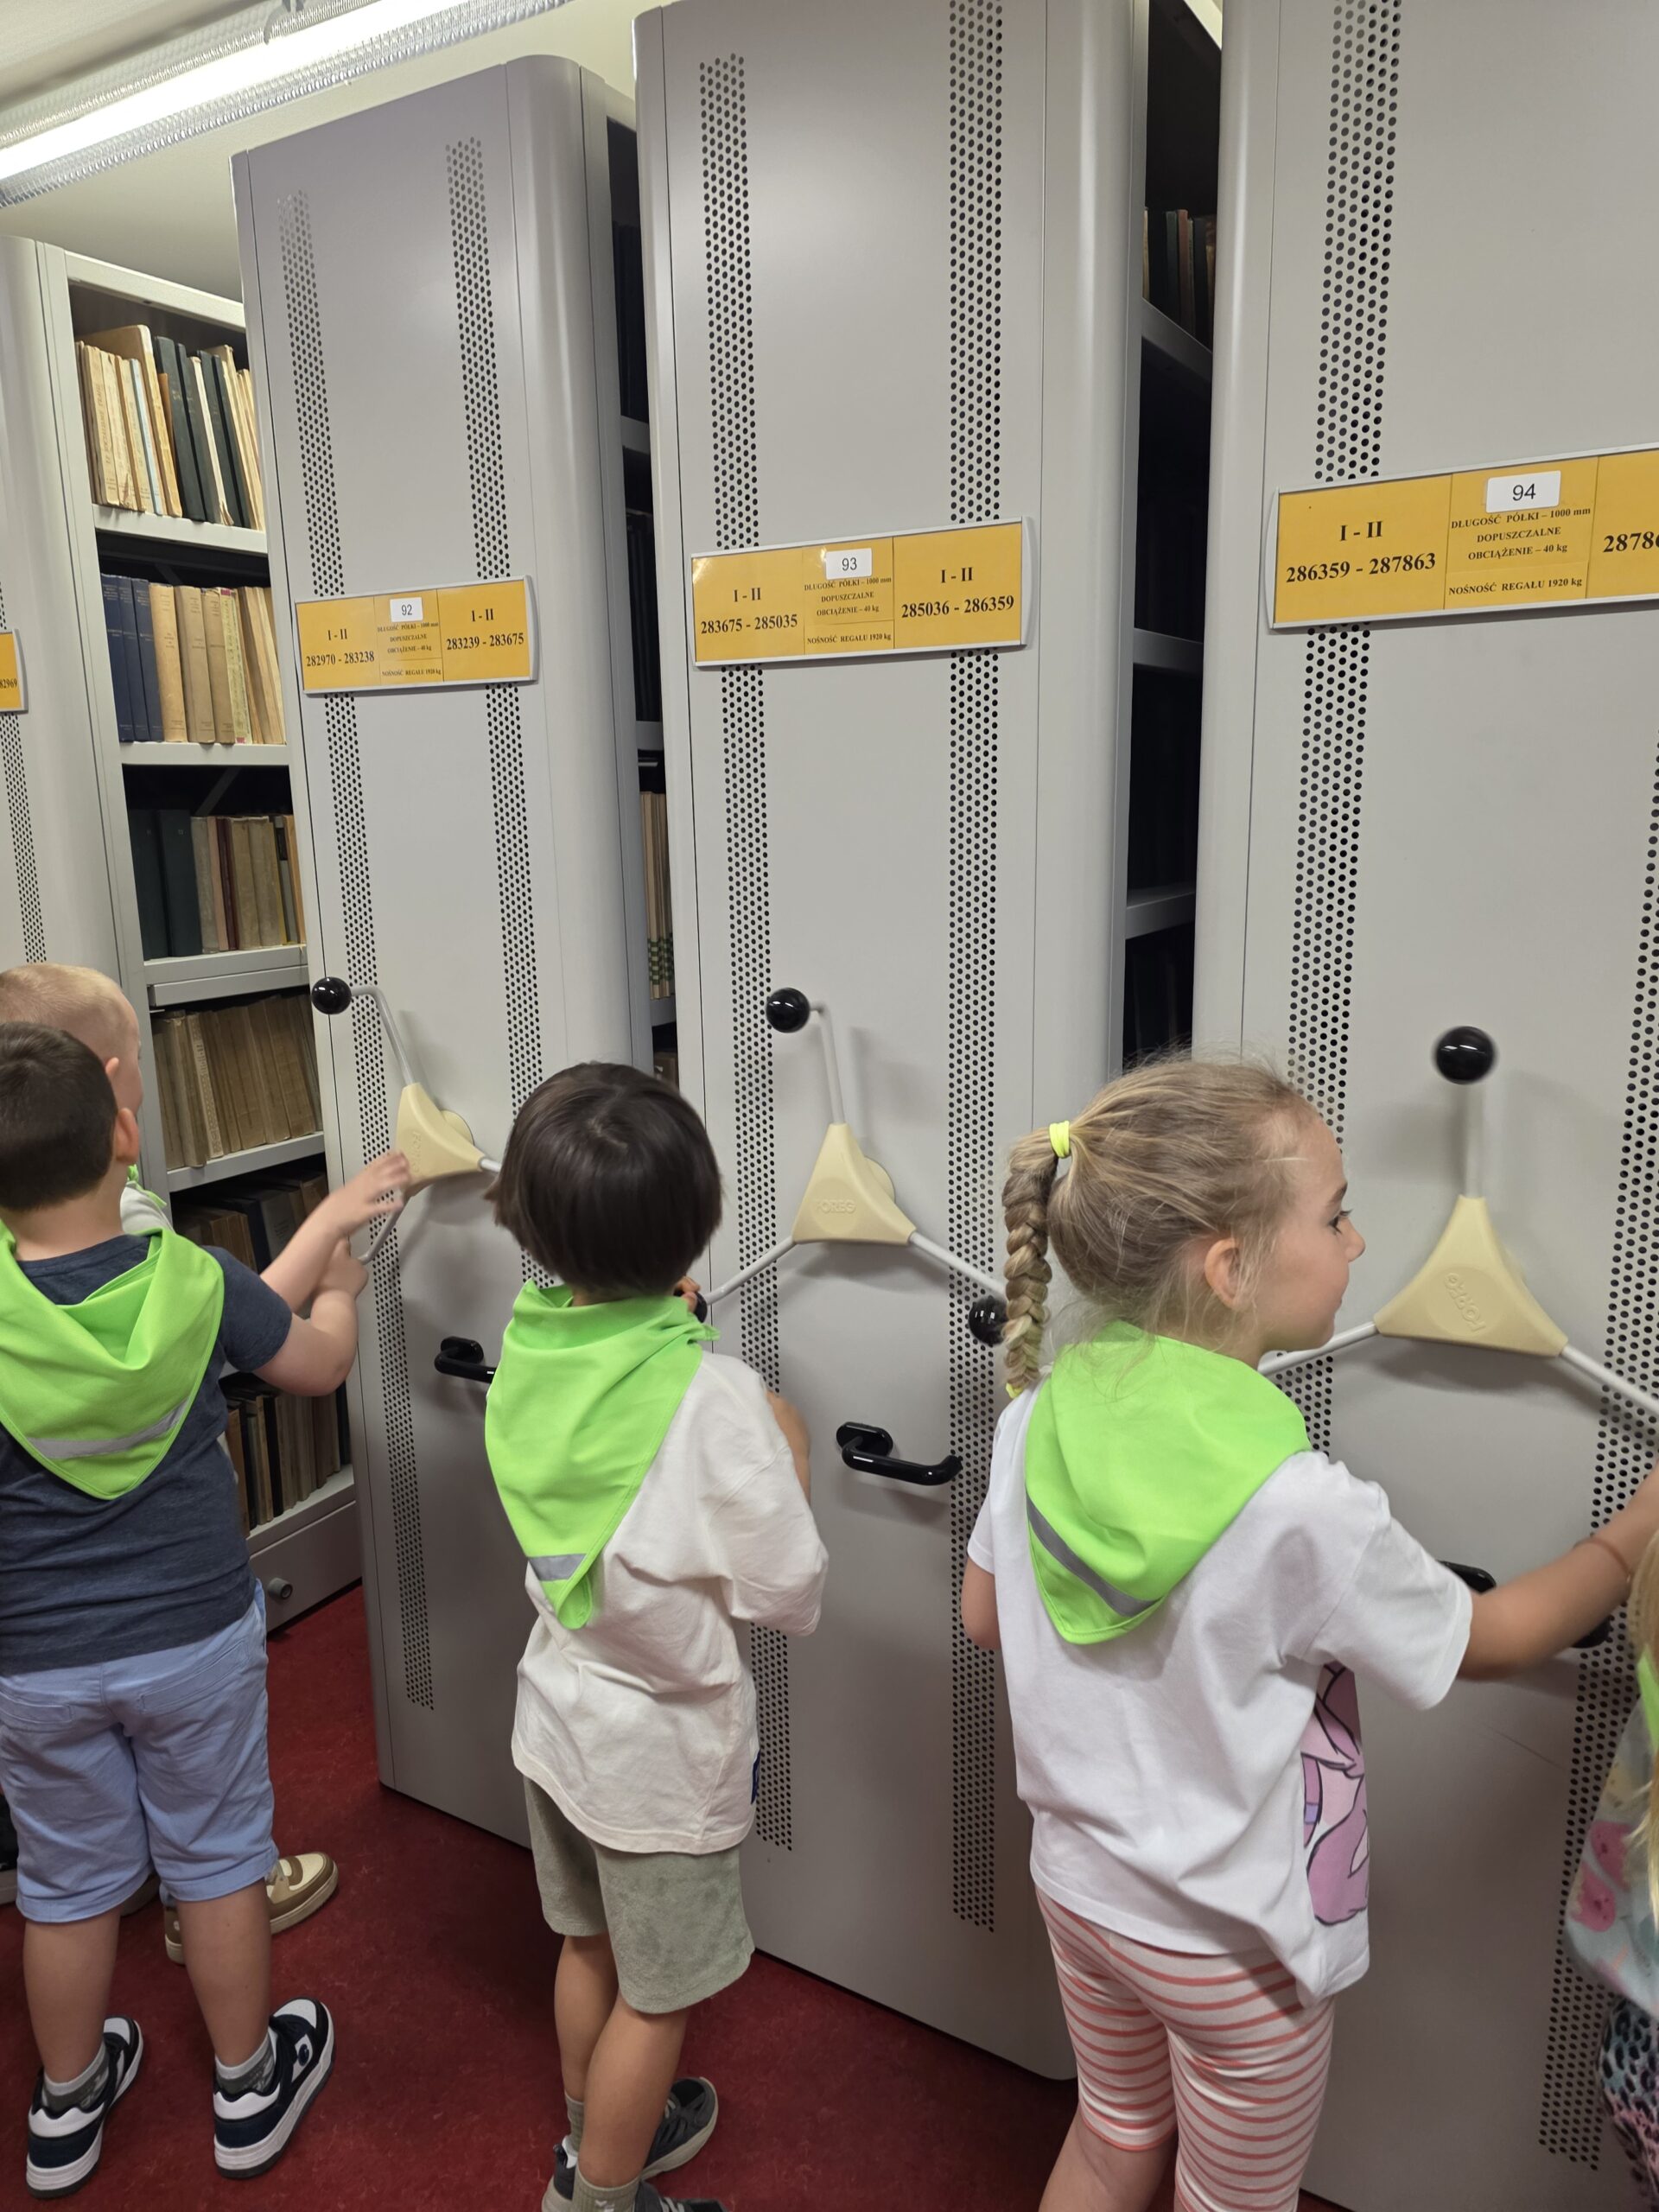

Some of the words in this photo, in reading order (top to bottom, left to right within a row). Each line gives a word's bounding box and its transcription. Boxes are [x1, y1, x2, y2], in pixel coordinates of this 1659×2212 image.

[1512, 483, 1536, 501] 94
[1451, 513, 1502, 529] DŁUGOŚĆ
[1506, 511, 1539, 523] PÓŁKI
[1550, 508, 1571, 518] 1000
[1573, 507, 1591, 516] mm
[1366, 520, 1382, 538] II
[1477, 526, 1561, 543] DOPUSZCZALNE
[1603, 531, 1659, 553] 2878
[1468, 544, 1533, 561] OBCIĄŻENIE
[1543, 544, 1554, 553] 40
[1556, 543, 1567, 553] kg
[842, 557, 857, 571] 93
[1286, 561, 1351, 583] 286359
[1369, 552, 1436, 575] 287863
[961, 567, 974, 582] II
[804, 581, 836, 591] DŁUGOŚĆ
[838, 578, 860, 588] PÓŁKI
[1448, 582, 1497, 596] NOŚNOŚĆ
[1502, 579, 1545, 592] REGAŁU
[1548, 578, 1568, 588] 1920
[1571, 577, 1582, 588] kg
[751, 588, 761, 601] II
[821, 591, 874, 602] DOPUSZCZALNE
[401, 604, 412, 616] 92
[817, 606, 858, 617] OBCIĄŻENIE
[901, 601, 950, 618] 285036
[964, 594, 1014, 614] 286359
[701, 618, 742, 634] 283675
[754, 613, 798, 630] 285035
[446, 636, 480, 651] 283239
[489, 632, 524, 647] 283675
[807, 634, 837, 645] NOŚNOŚĆ
[840, 633, 868, 643] REGAŁU
[884, 632, 892, 641] kg
[307, 654, 336, 667] 282970
[344, 651, 375, 664] 283238
[1443, 1271, 1486, 1332] FOREG
